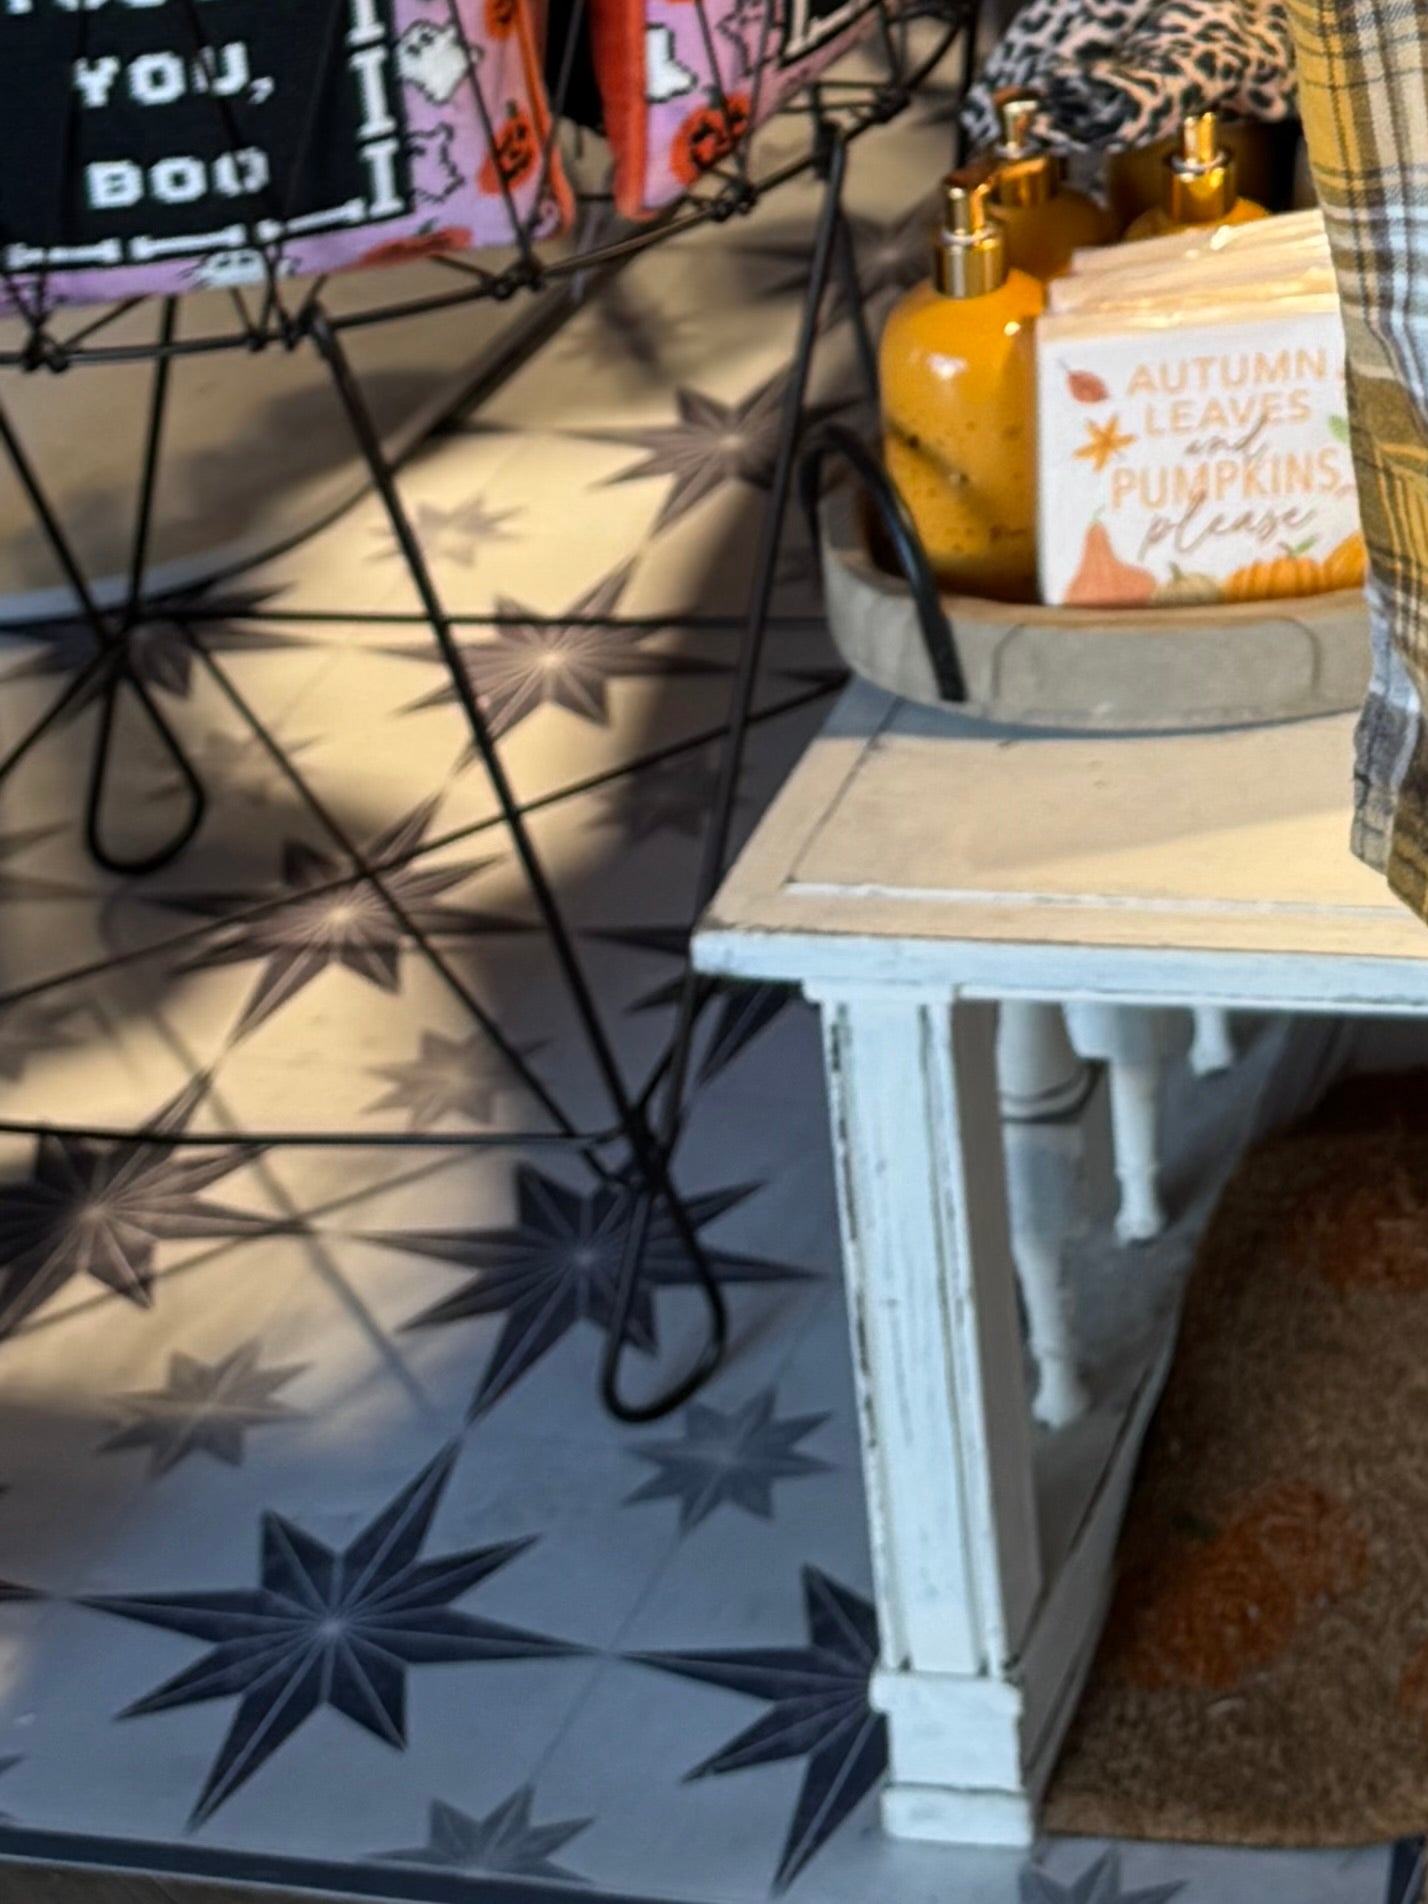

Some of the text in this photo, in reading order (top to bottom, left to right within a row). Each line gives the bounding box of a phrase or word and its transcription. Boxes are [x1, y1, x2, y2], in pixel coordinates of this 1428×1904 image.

[84, 145, 271, 210] BOO
[1125, 348, 1328, 398] AUTUMN
[1143, 388, 1312, 437] LEAVES
[1184, 411, 1270, 465] and
[1110, 446, 1341, 512] PUMPKINS
[1136, 487, 1319, 563] please
